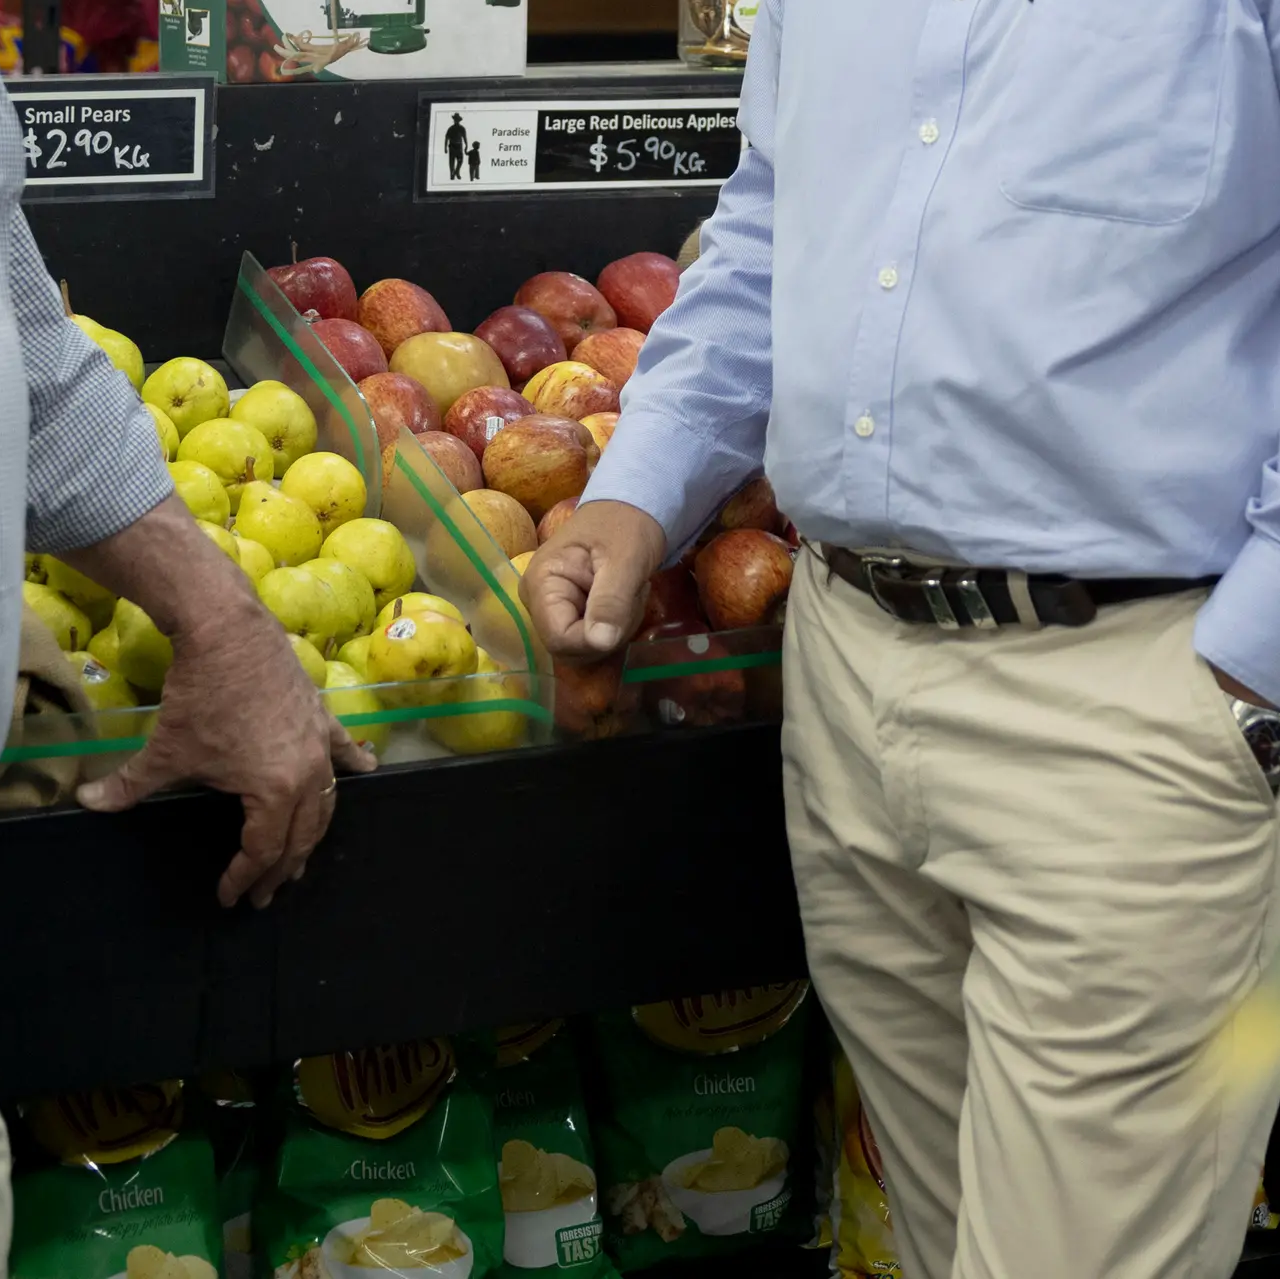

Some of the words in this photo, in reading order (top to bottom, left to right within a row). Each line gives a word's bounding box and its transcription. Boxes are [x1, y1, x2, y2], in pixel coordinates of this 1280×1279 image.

[25, 106, 75, 124] Small
[81, 107, 131, 123] Pears
[545, 115, 586, 133] Large
[590, 115, 619, 130] Red
[622, 114, 684, 130] Delicous
[686, 113, 737, 132] Apples
[491, 127, 531, 138] Paradise
[23, 127, 113, 170] $2.90
[114, 144, 150, 170] KG
[498, 143, 522, 152] Farm
[491, 157, 529, 168] Markets
[693, 1072, 757, 1096] Chicken
[494, 1087, 536, 1109] icken
[349, 1159, 417, 1181] Chicken
[97, 1184, 164, 1215] Chicken
